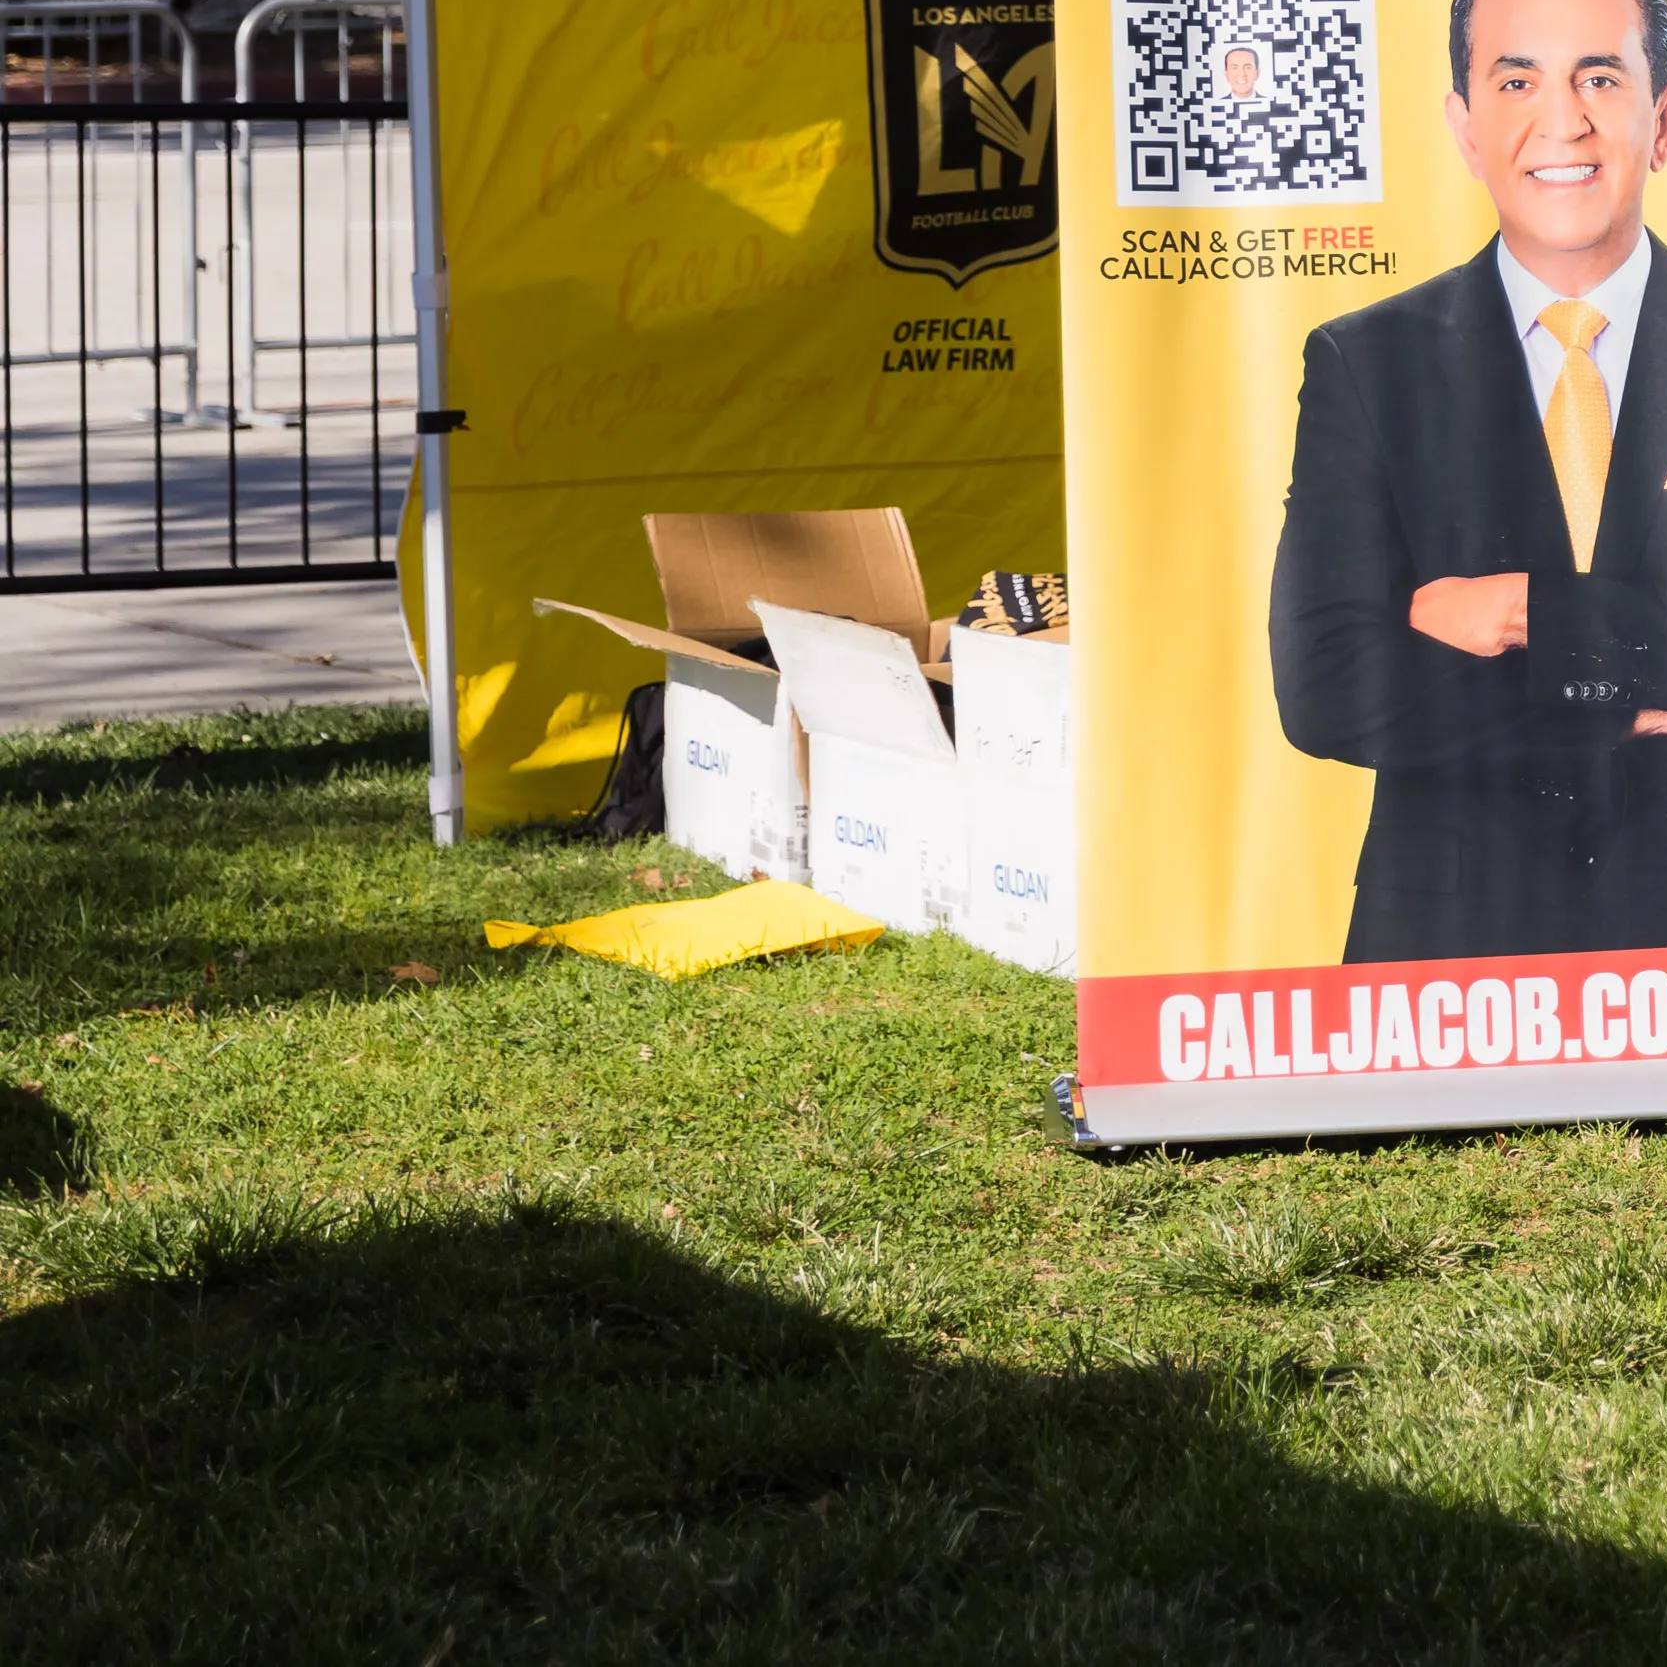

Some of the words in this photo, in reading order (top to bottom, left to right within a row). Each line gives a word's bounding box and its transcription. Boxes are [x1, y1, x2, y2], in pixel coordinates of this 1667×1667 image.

[912, 7, 958, 27] LOS
[959, 3, 1055, 24] ANGELES
[911, 208, 991, 231] FOOTBALL
[991, 203, 1035, 221] CLUB
[1121, 230, 1201, 255] SCAN
[1209, 229, 1229, 255] &
[1237, 228, 1296, 253] GET
[1303, 225, 1375, 250] FREE
[1282, 251, 1398, 277] MERCH!
[892, 317, 1012, 343] OFFICIAL
[882, 349, 941, 373] LAW
[946, 347, 1017, 372] FIRM
[686, 739, 732, 778] GILDAN
[834, 814, 889, 855] GILDAN
[993, 864, 1050, 905] GILDAN
